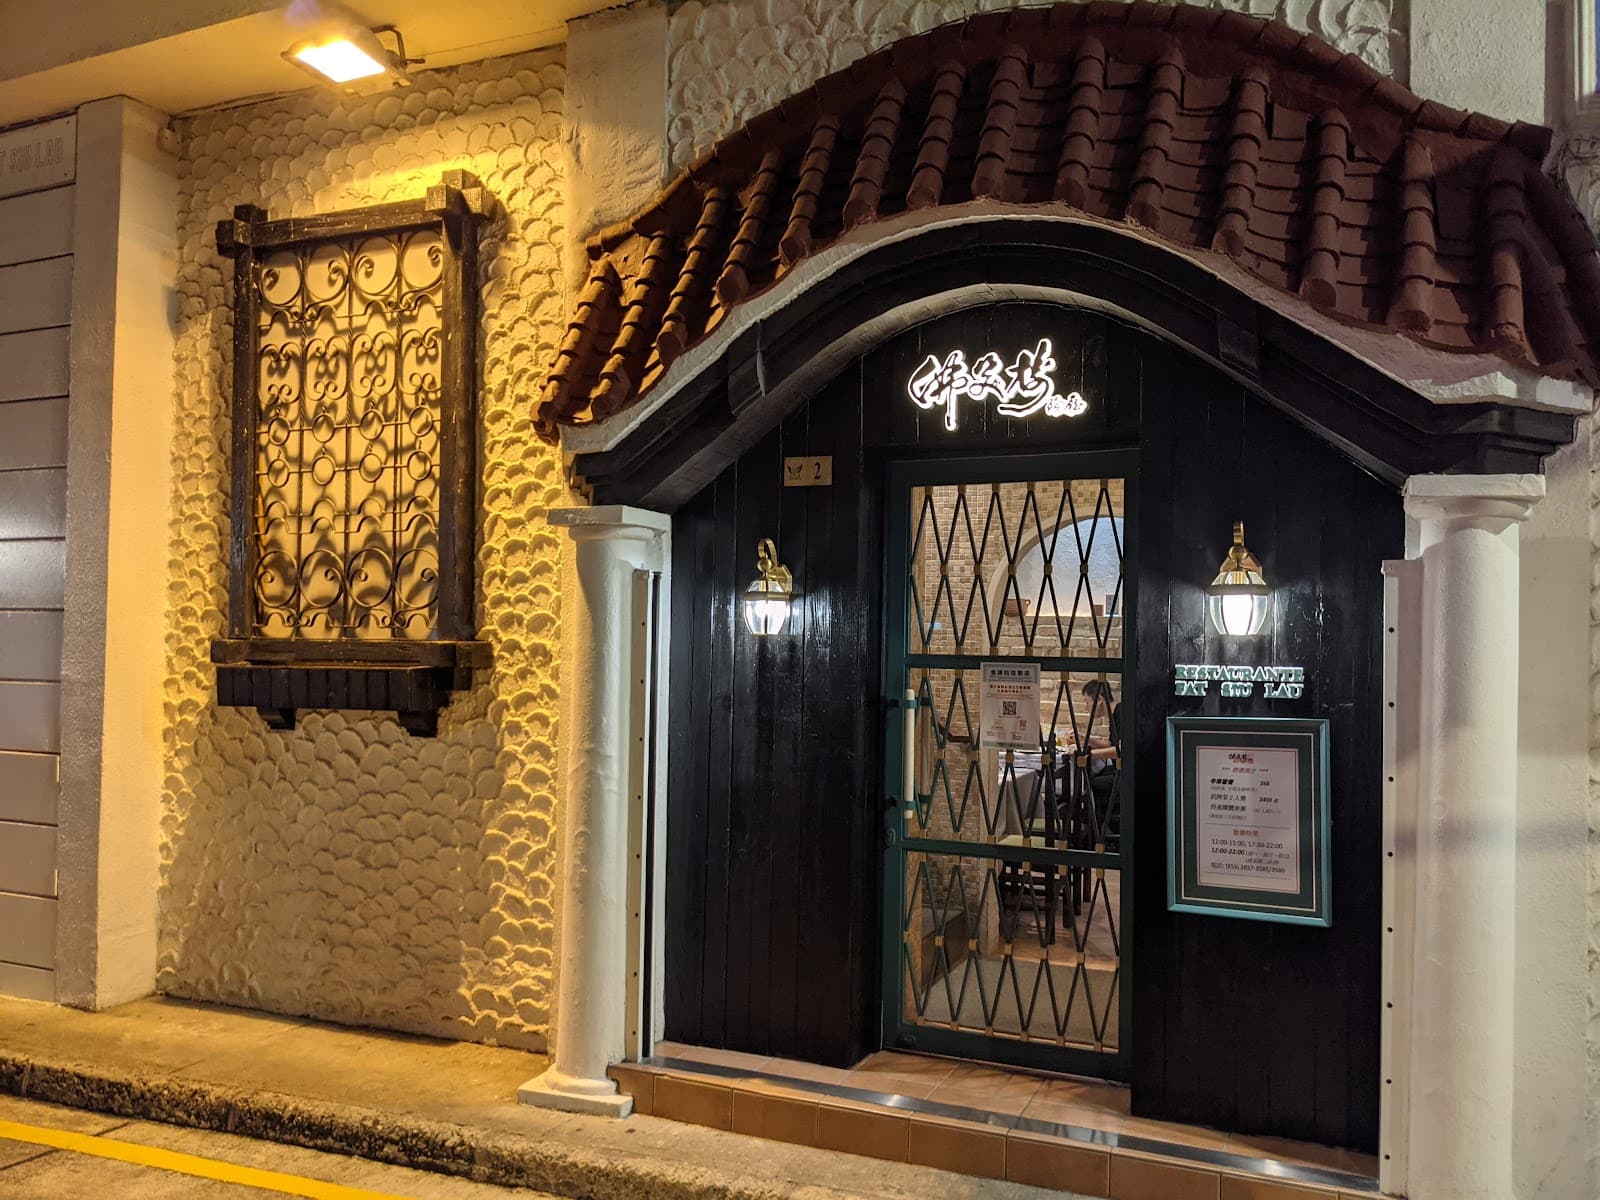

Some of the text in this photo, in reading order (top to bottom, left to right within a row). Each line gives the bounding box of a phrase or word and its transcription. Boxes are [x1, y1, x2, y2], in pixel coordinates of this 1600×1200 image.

[1174, 664, 1304, 682] RESTAURANTE
[1174, 680, 1304, 699] FAT SIU LAU
